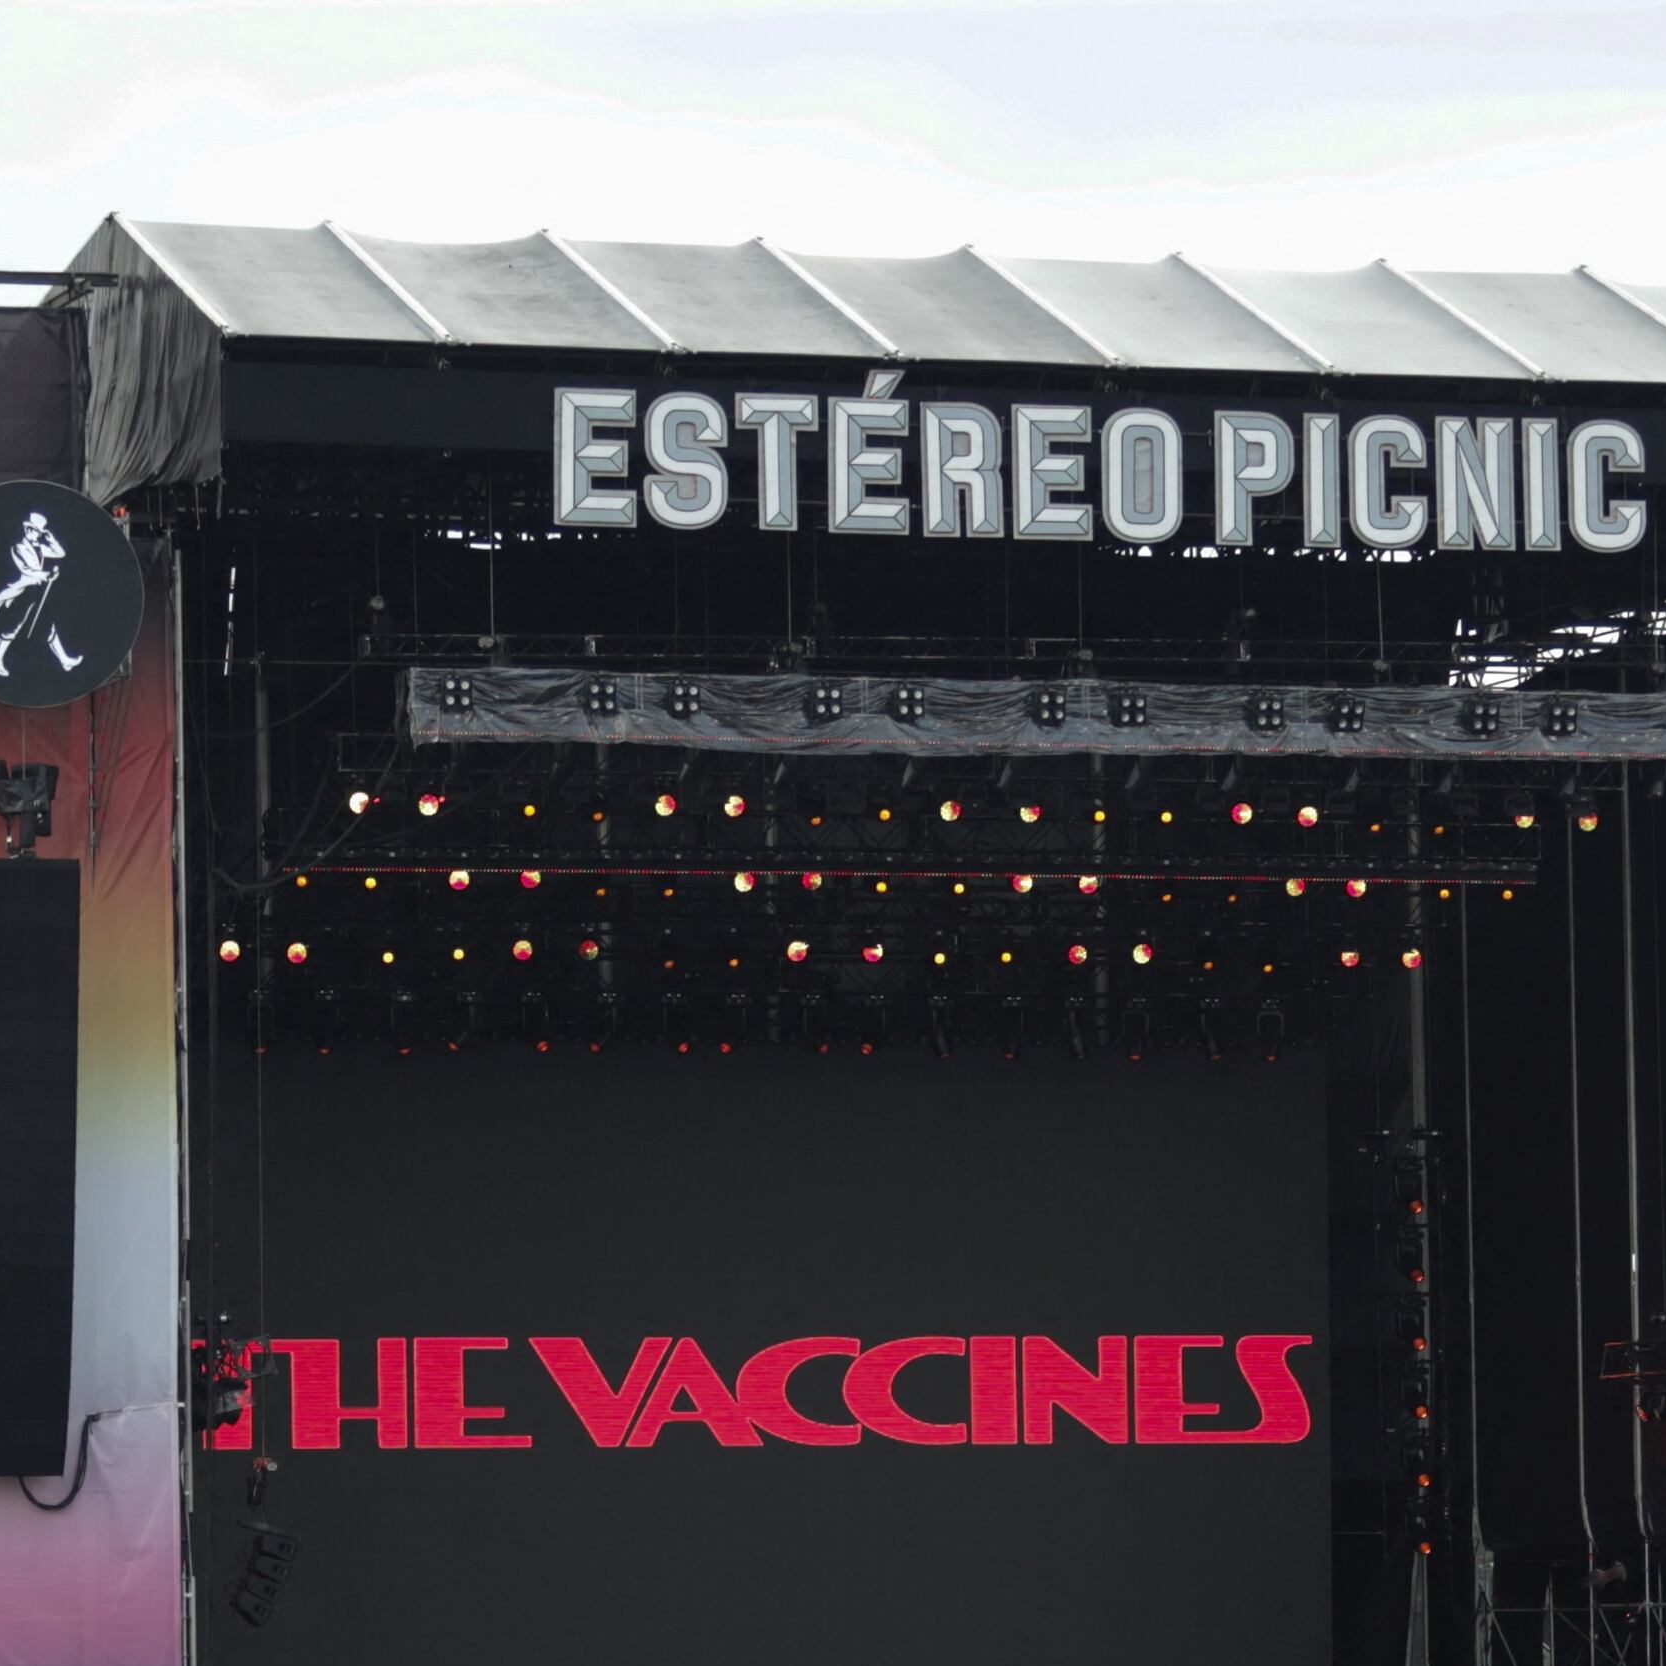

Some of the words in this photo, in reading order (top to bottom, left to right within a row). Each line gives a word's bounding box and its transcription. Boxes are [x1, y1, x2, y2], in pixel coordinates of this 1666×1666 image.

[553, 368, 1185, 545] ESTÉREO
[1213, 409, 1646, 555] PICNIC
[528, 1335, 1312, 1447] VACCINES
